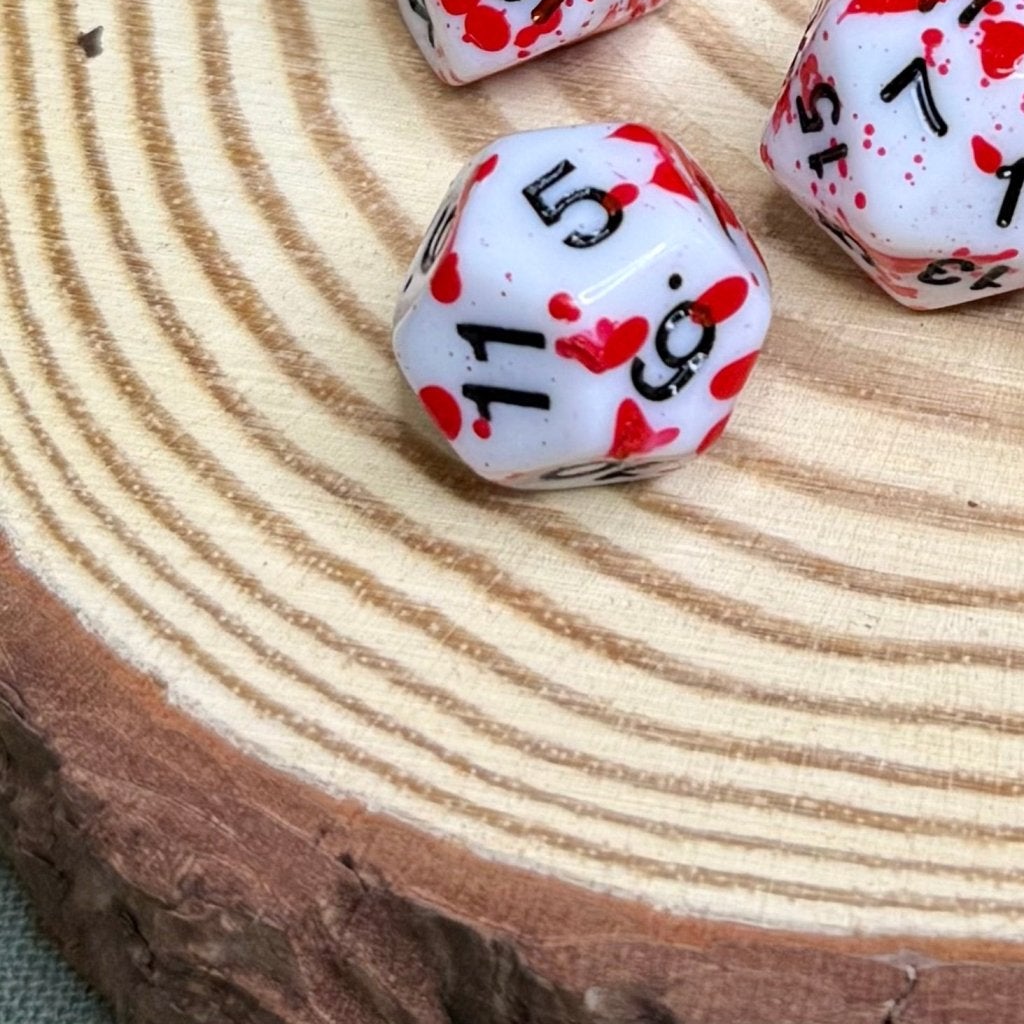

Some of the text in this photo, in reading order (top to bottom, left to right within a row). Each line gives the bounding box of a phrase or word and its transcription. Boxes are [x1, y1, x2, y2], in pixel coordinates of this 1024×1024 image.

[796, 83, 849, 180] 15
[880, 57, 948, 136] 7
[522, 159, 624, 248] 5
[456, 323, 551, 421] 11
